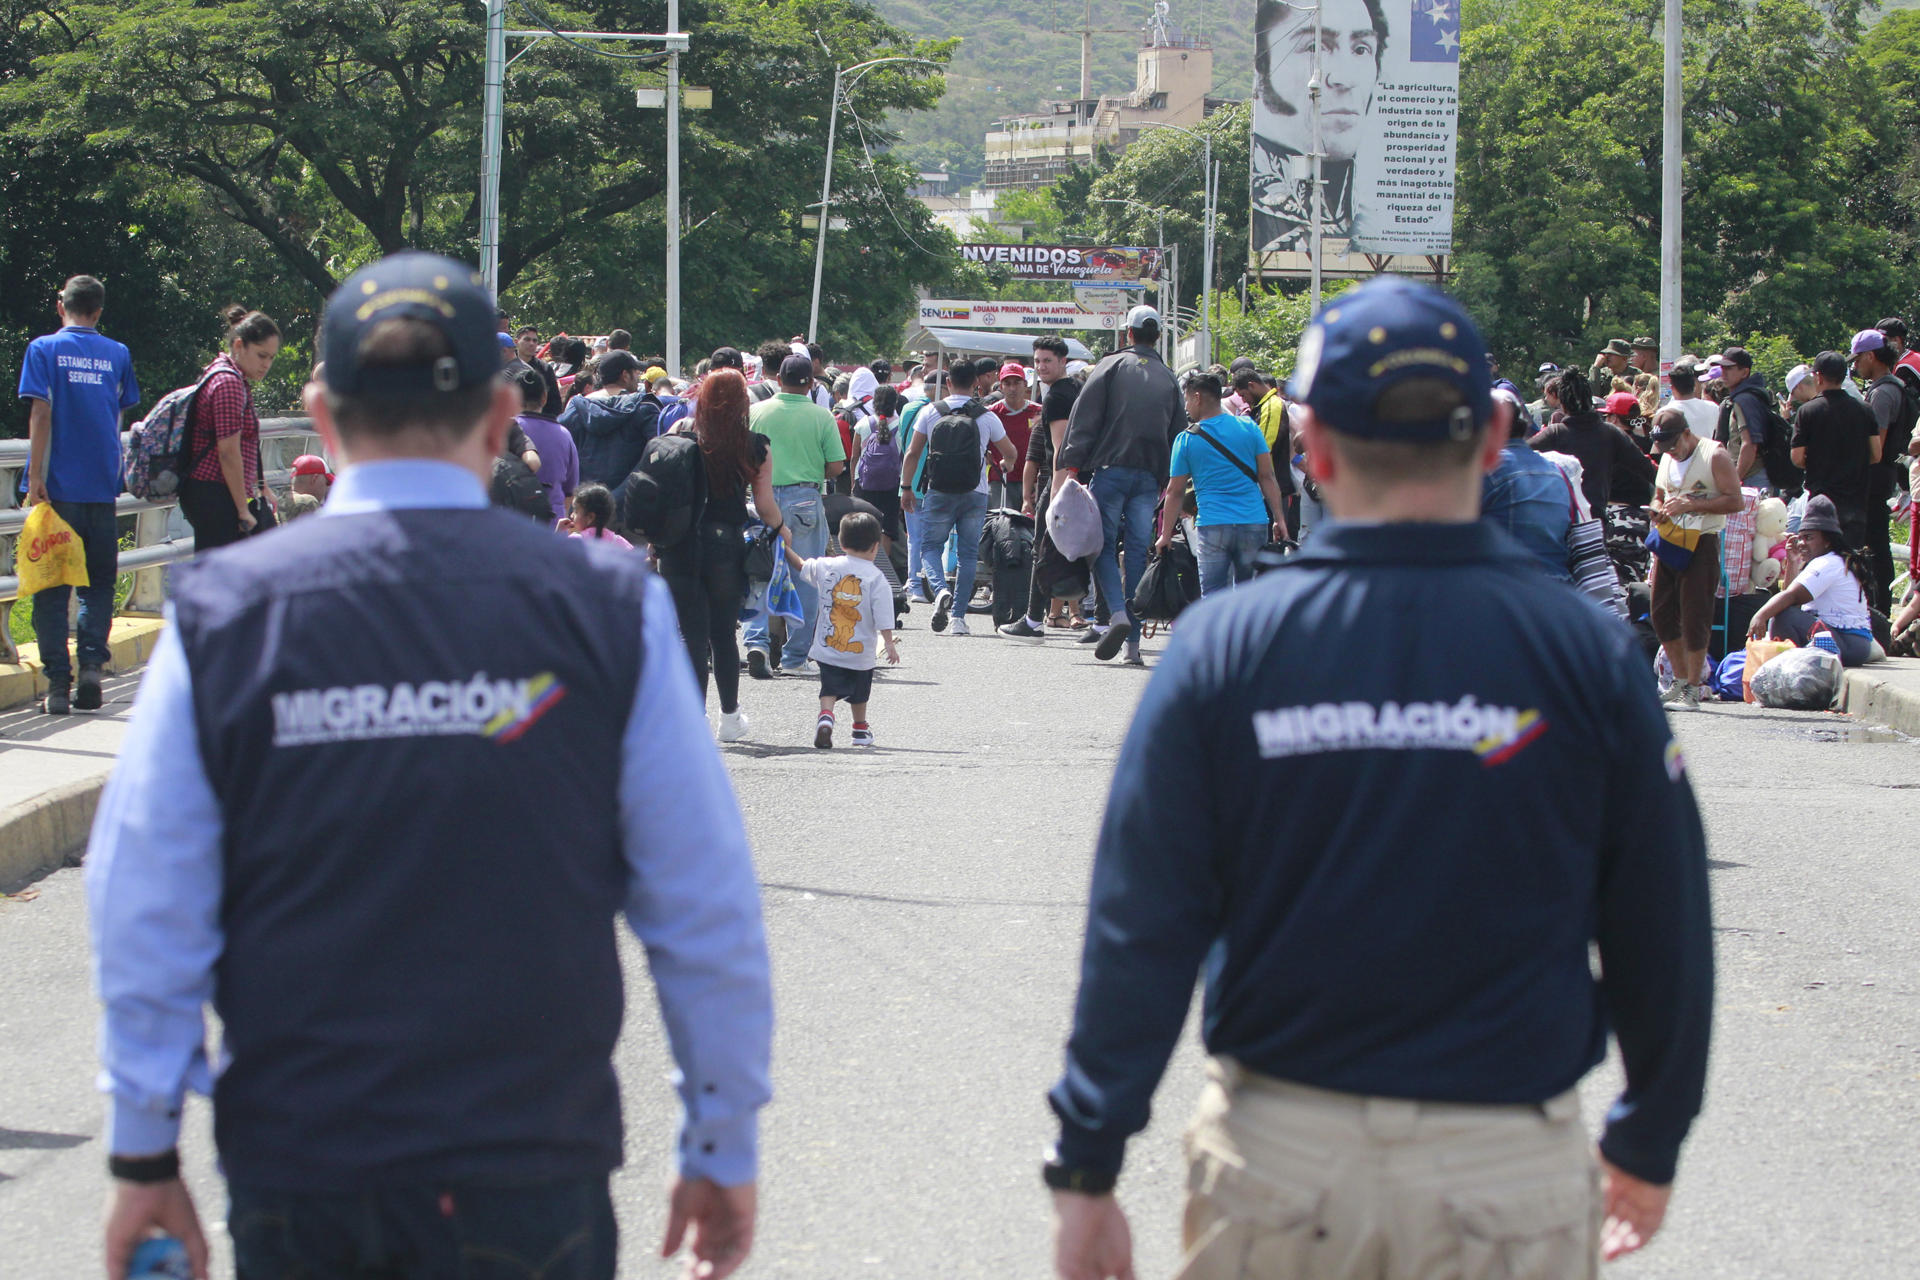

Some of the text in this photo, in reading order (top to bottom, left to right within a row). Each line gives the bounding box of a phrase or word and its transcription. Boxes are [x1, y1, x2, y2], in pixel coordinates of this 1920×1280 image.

[1398, 84, 1456, 93] agricultura,
[1390, 95, 1435, 104] comercio
[1439, 97, 1445, 105] y
[1447, 96, 1456, 104] la
[1378, 106, 1422, 115] industria
[1445, 108, 1454, 116] el
[1387, 119, 1418, 128] origen
[1421, 119, 1433, 127] de
[1383, 131, 1449, 141] abundancia y
[1386, 144, 1445, 152] prosperidad
[1384, 155, 1447, 165] nacional y el
[1386, 168, 1444, 177] verdadero y
[1377, 179, 1453, 189] más inagotable
[1376, 191, 1452, 200] manantial de la
[1387, 203, 1441, 212] riqueza del
[1394, 215, 1433, 223] Estado"
[1036, 264, 1049, 274] DE
[1050, 262, 1113, 279] Venezuela
[973, 305, 999, 313] ADUANA
[1001, 306, 1033, 314] PRINCIPAL
[1036, 306, 1049, 314] SAN
[1022, 316, 1074, 325] ZONA PRIMARIA
[57, 355, 113, 372] ESTAMOS PARA
[68, 370, 103, 385] SERVIRLE
[272, 671, 529, 730] MIGRACIÓN
[1253, 695, 1517, 748] MIGRACIÓN
